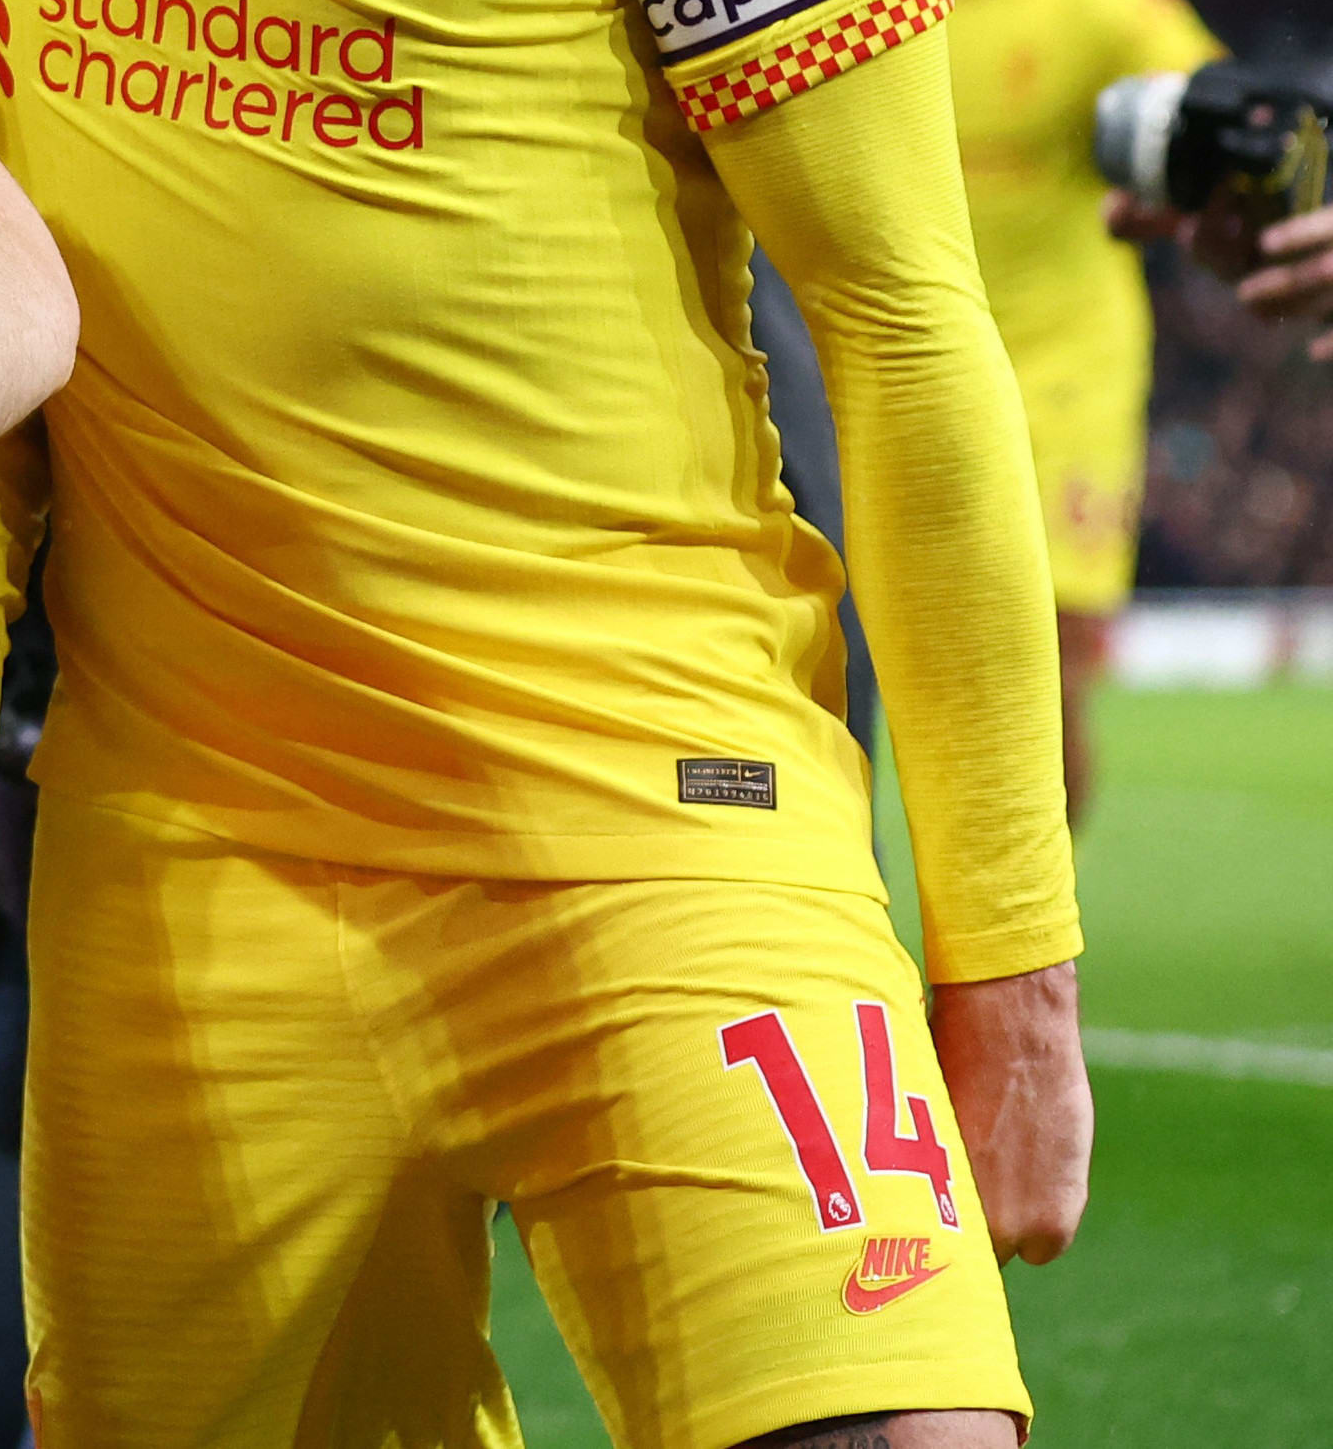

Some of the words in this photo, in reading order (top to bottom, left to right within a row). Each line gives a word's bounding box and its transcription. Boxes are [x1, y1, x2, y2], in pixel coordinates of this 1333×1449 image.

[39, 36, 424, 150] chartered
[717, 999, 962, 1234] 14
[860, 1237, 932, 1278] NIKE
